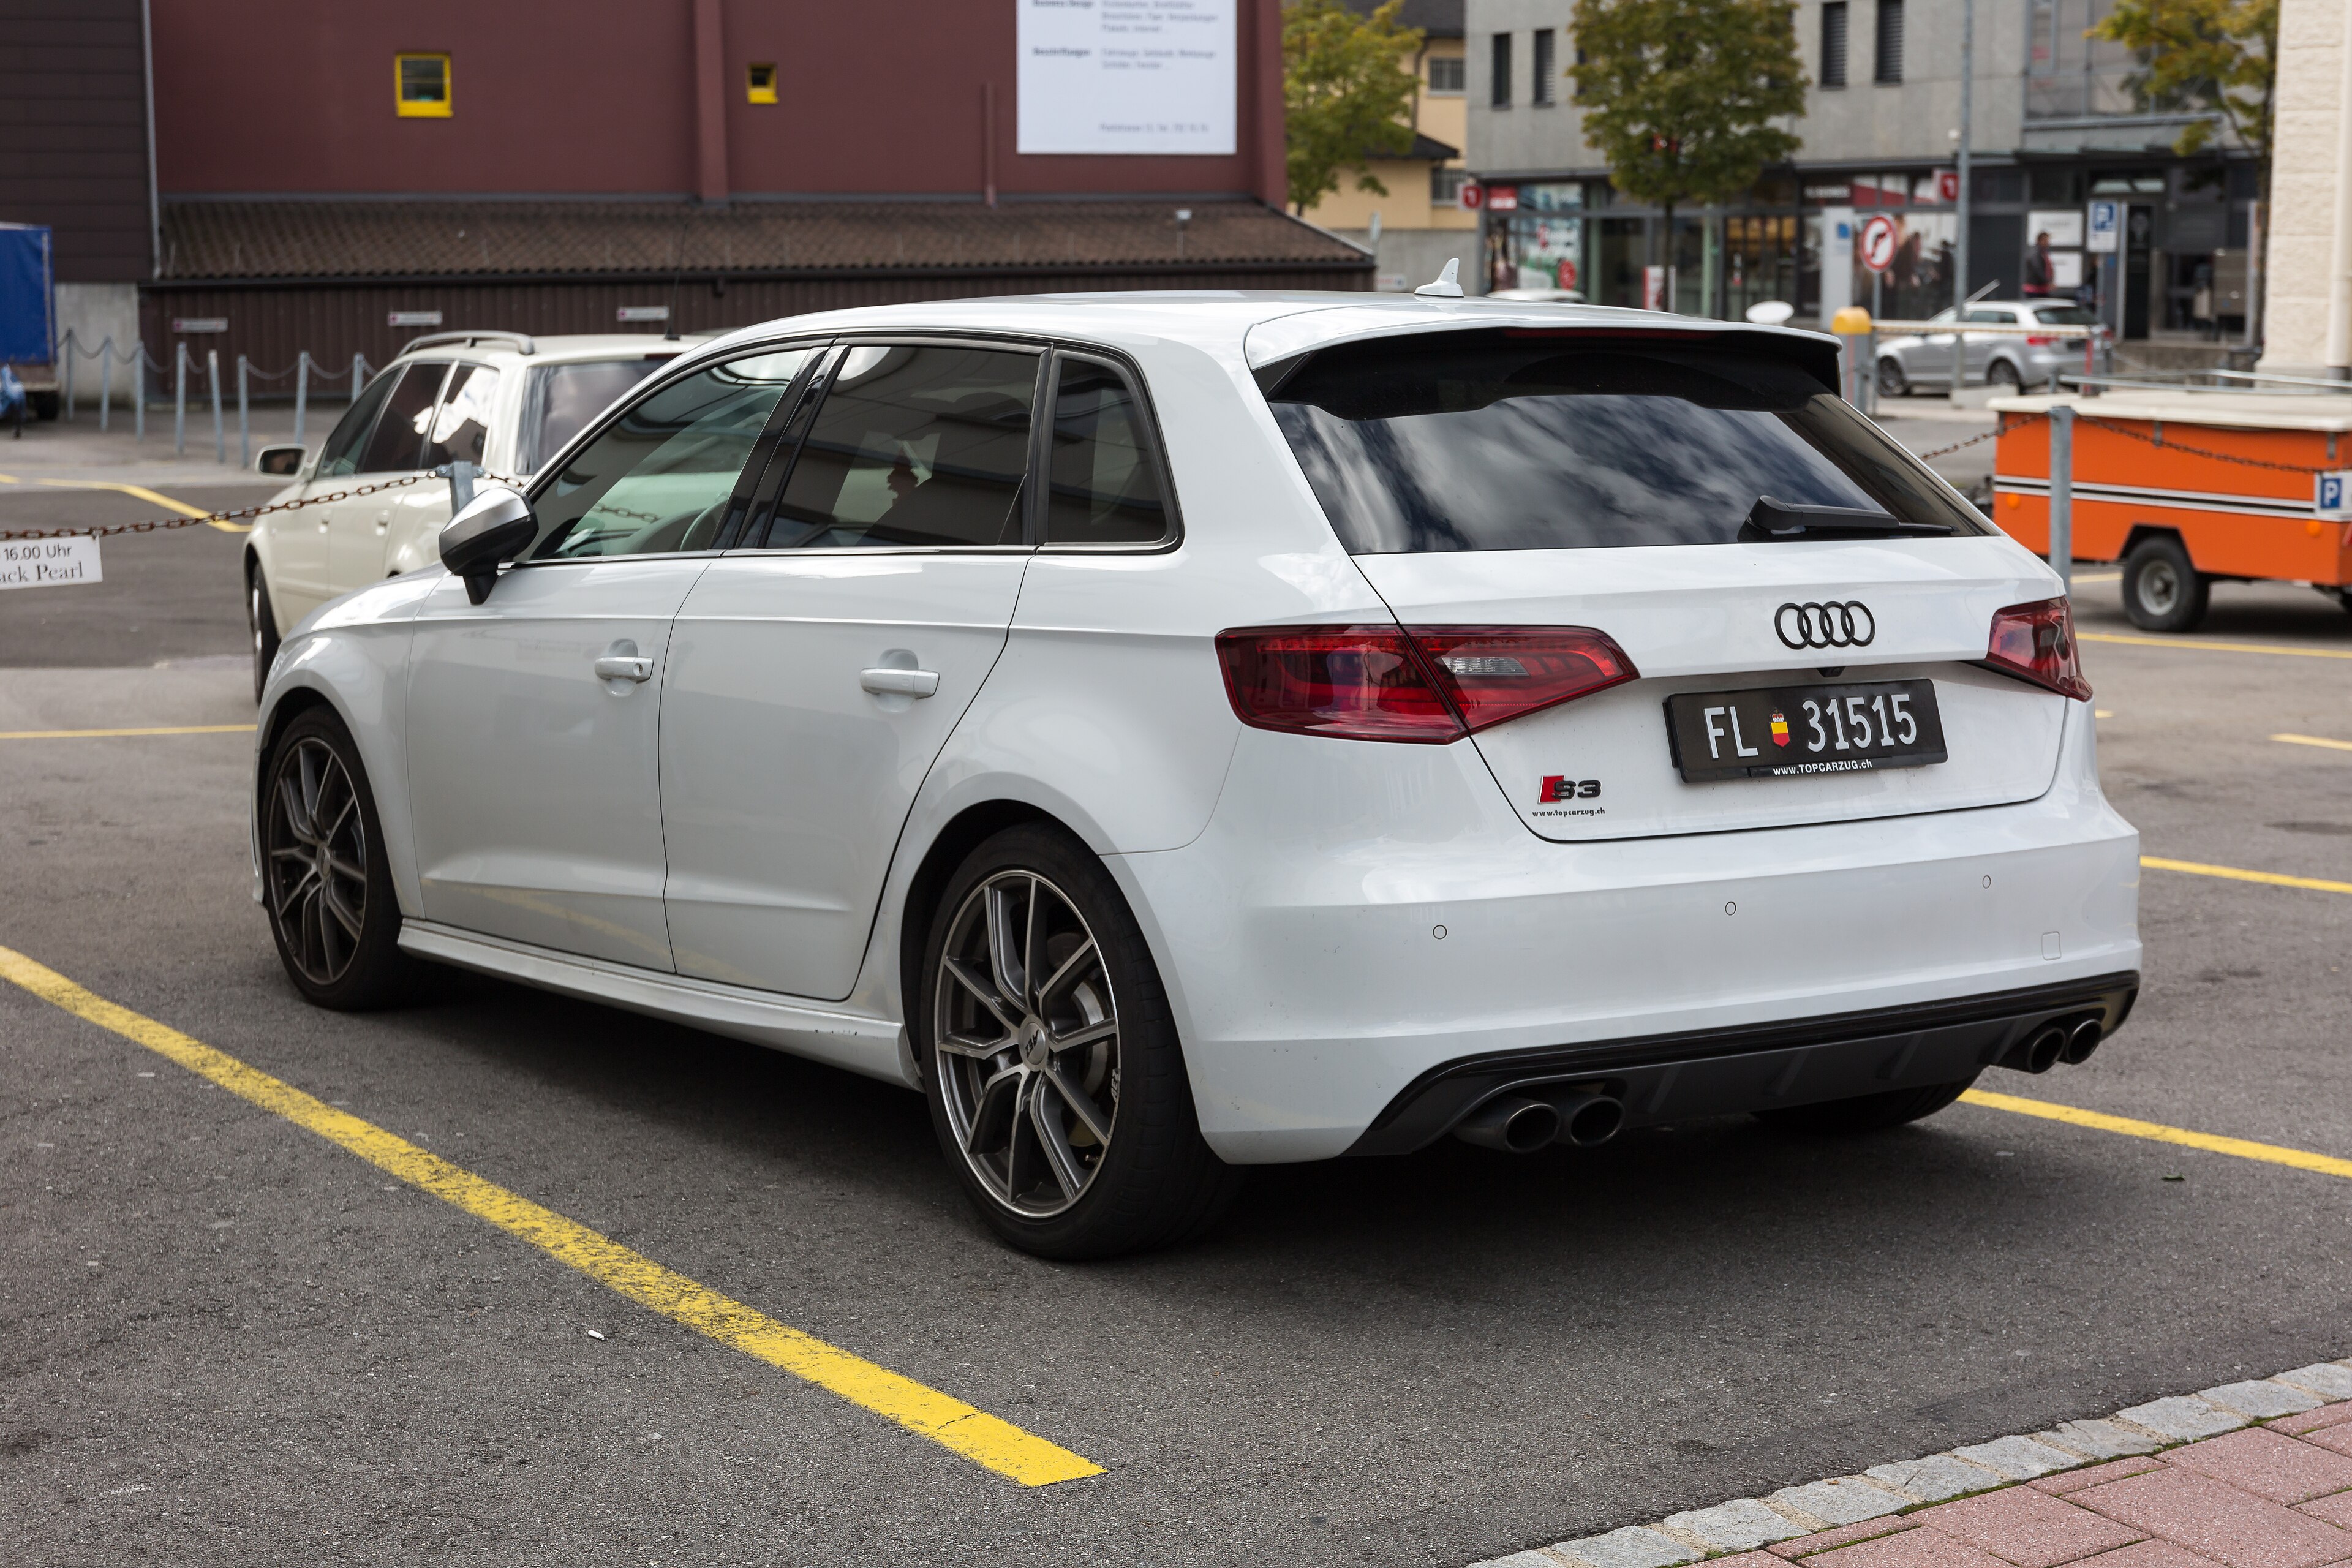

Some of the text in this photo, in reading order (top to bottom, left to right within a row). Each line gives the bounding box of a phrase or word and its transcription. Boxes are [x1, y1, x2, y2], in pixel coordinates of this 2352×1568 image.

[2324, 481, 2338, 506] P
[3, 543, 72, 561] 16.00 Uhr
[36, 560, 83, 581] Pearl
[1703, 693, 1917, 759] FL 31515
[1773, 759, 1872, 776] www.TOPCARZUG.ch
[1552, 780, 1602, 799] S3
[1532, 807, 1605, 818] www.topcarzug.ch
